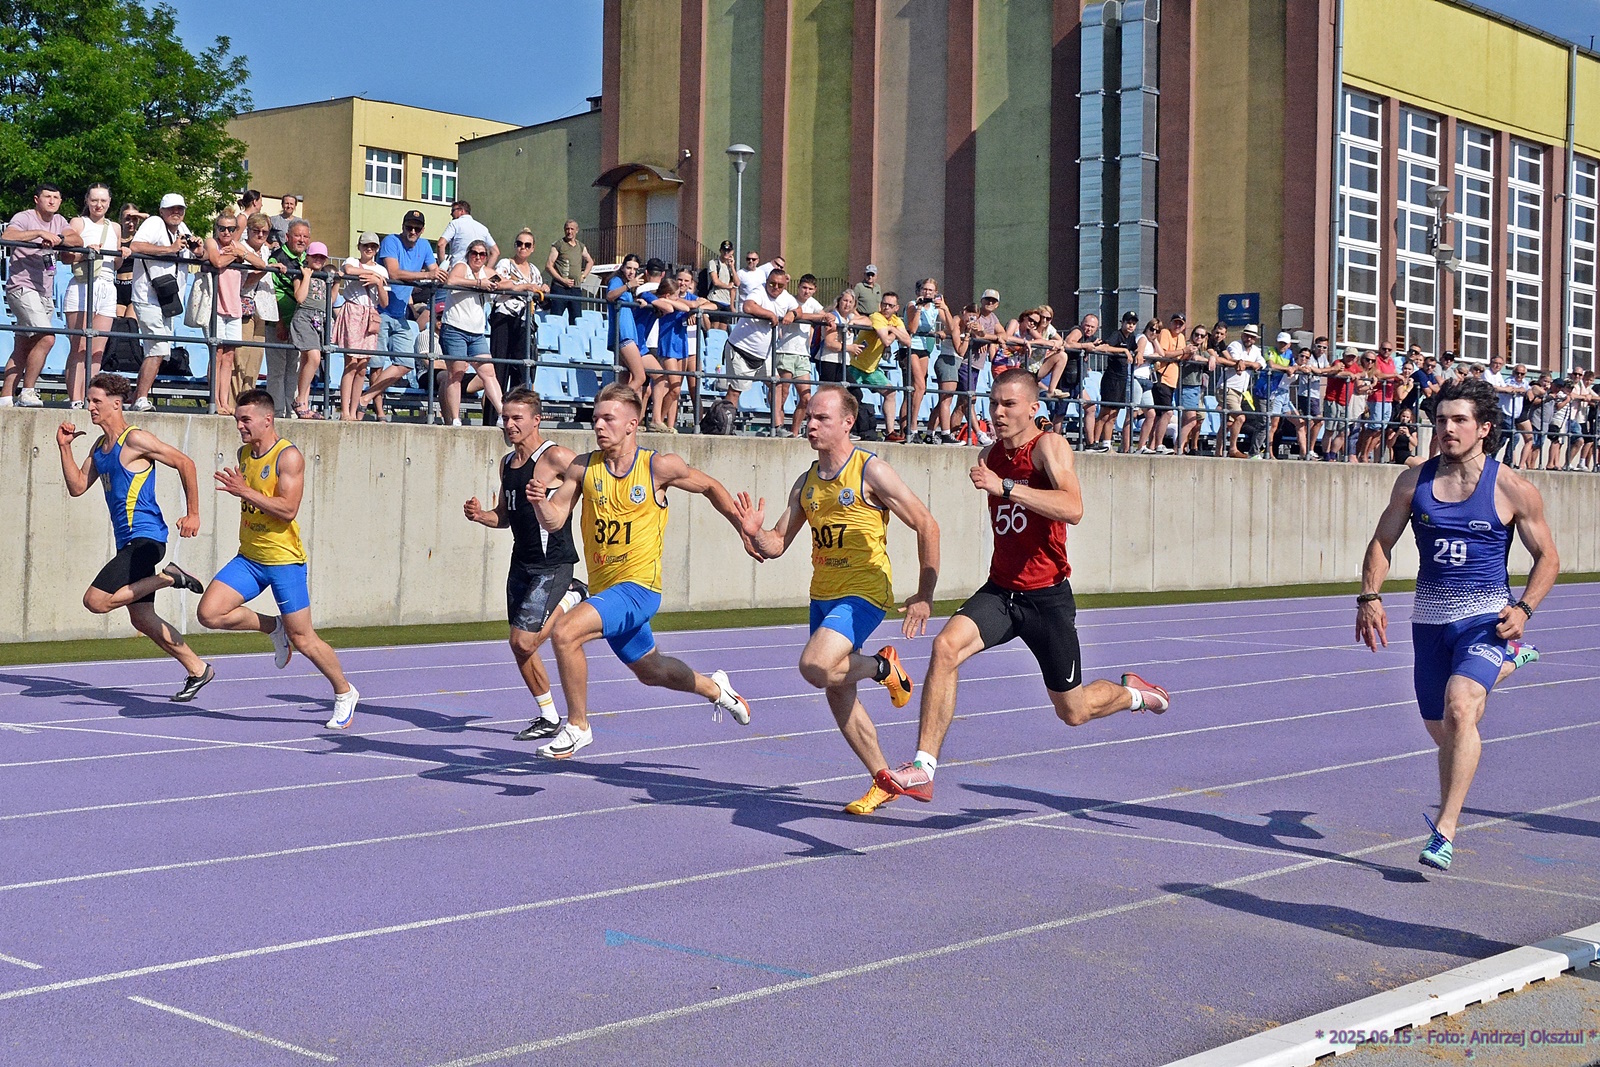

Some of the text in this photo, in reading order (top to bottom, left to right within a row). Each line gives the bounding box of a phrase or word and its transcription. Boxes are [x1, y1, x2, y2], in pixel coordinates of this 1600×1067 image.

[594, 518, 632, 545] 321
[990, 502, 1028, 535] 56
[1433, 538, 1467, 566] 29
